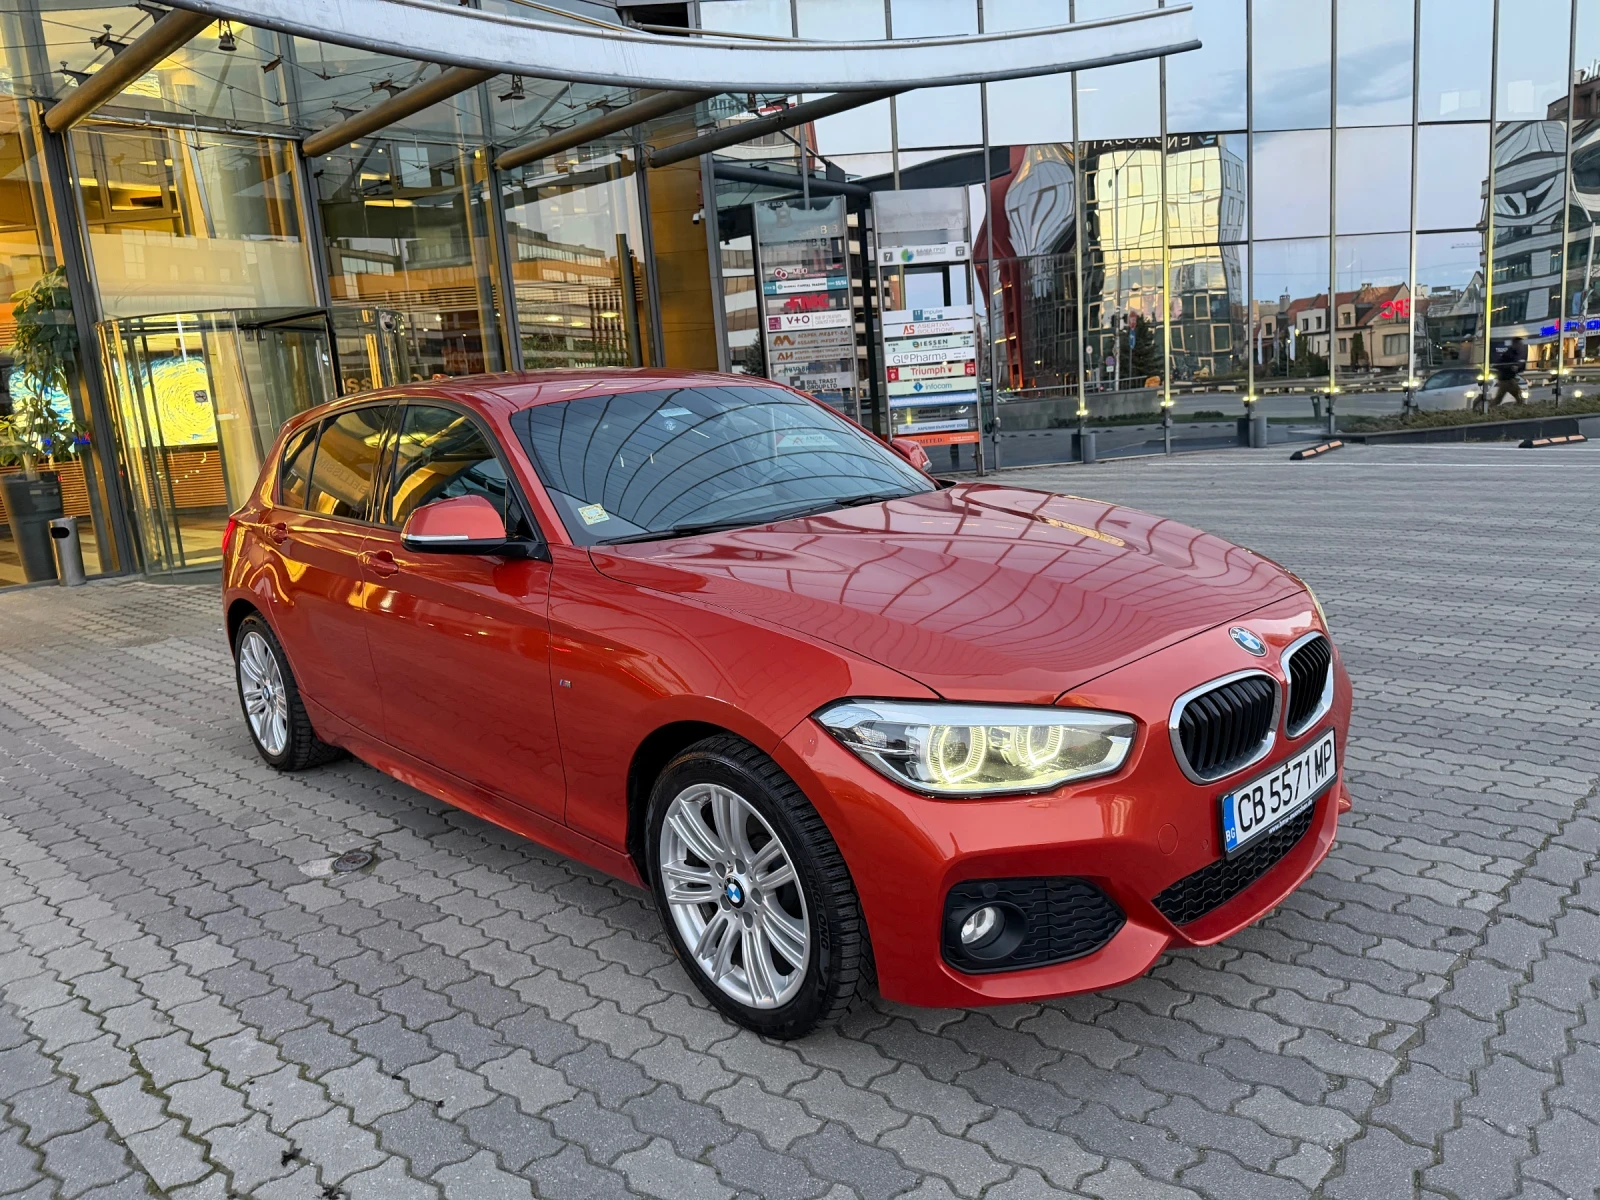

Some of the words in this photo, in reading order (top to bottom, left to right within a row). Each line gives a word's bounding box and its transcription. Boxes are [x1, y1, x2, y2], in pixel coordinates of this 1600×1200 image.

[886, 253, 891, 261] 7
[917, 326, 955, 334] SOLUTIONS
[910, 366, 946, 376] Triumph
[925, 382, 952, 390] infocom
[1238, 785, 1266, 833] CB
[1269, 755, 1311, 814] 5571
[1314, 739, 1332, 783] MP
[1225, 827, 1236, 842] BG
